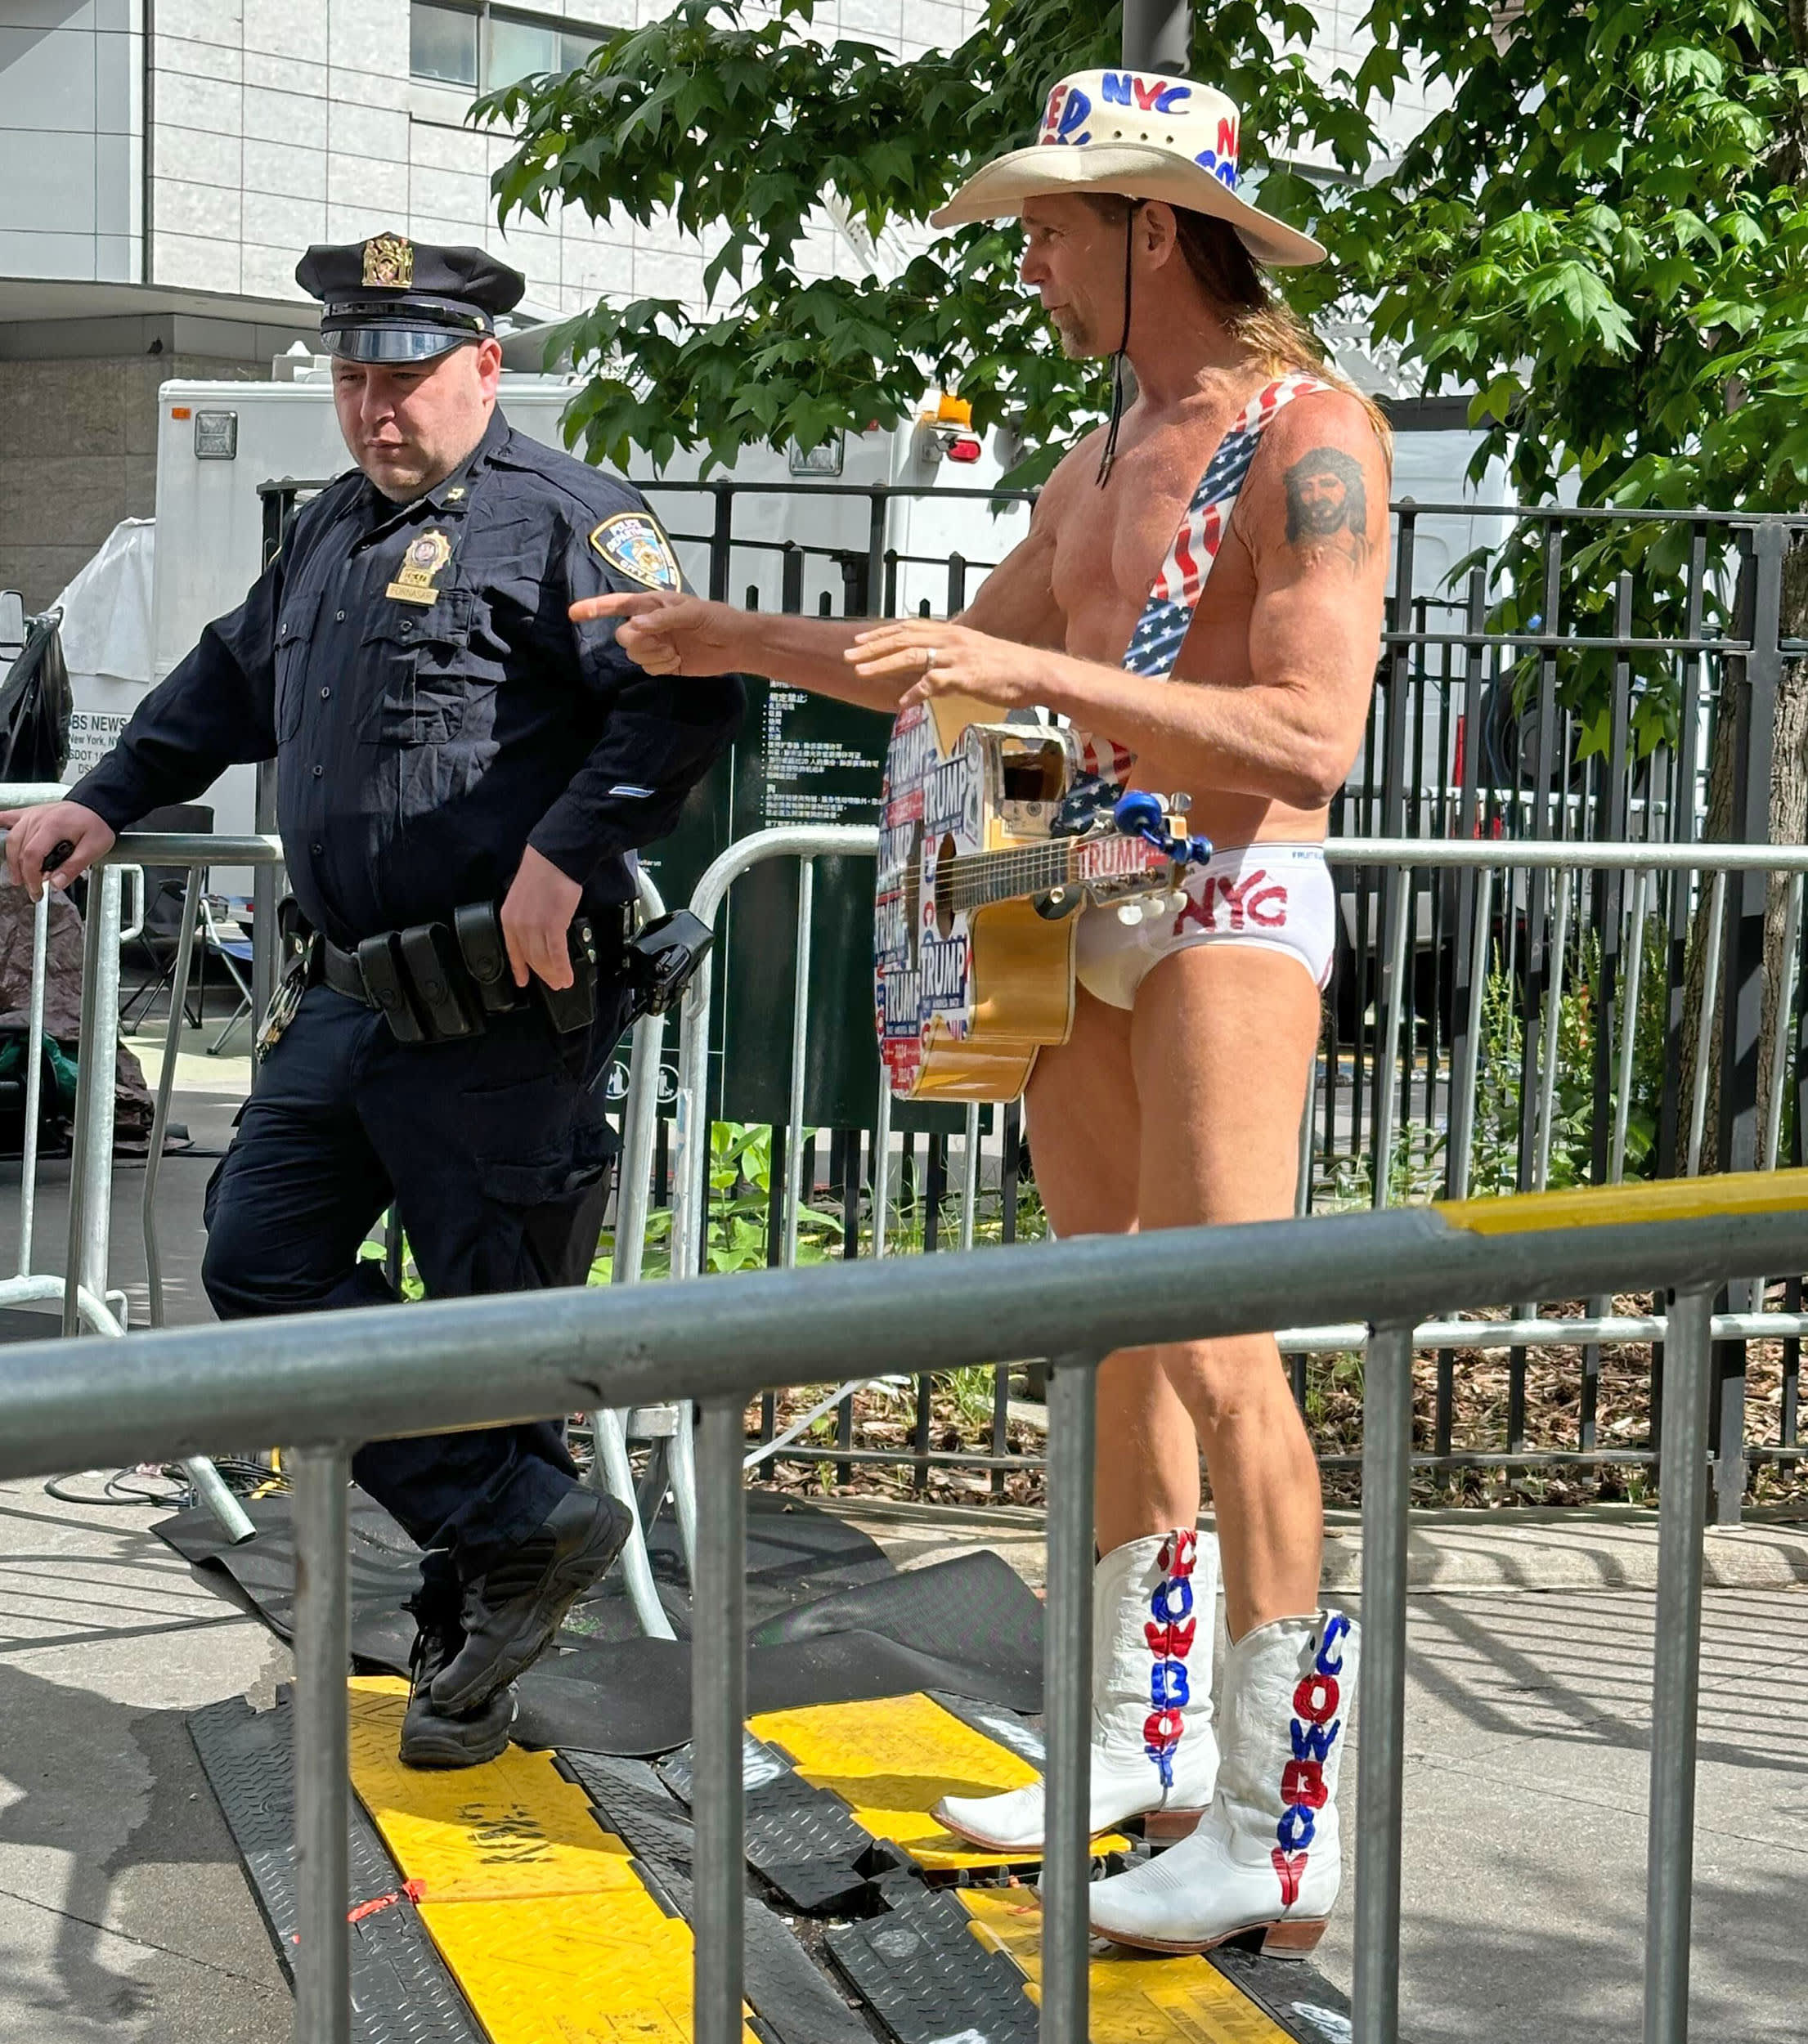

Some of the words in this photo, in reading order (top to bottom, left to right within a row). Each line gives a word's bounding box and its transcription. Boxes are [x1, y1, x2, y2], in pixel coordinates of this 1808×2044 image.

[1043, 84, 1092, 135] ED
[1101, 72, 1192, 115] NYC
[1217, 116, 1240, 157] N
[71, 715, 87, 730] BS
[92, 715, 127, 732] NEWS
[70, 749, 92, 760] SDOT
[923, 760, 967, 825] TRUMP
[1080, 838, 1146, 880] TRUMP
[1173, 868, 1288, 937] NYC
[921, 942, 965, 997] TRUMP
[886, 972, 921, 1022] TRUMP
[1142, 1527, 1197, 1788] COWBOY
[1269, 1613, 1352, 1907] COWBOY
